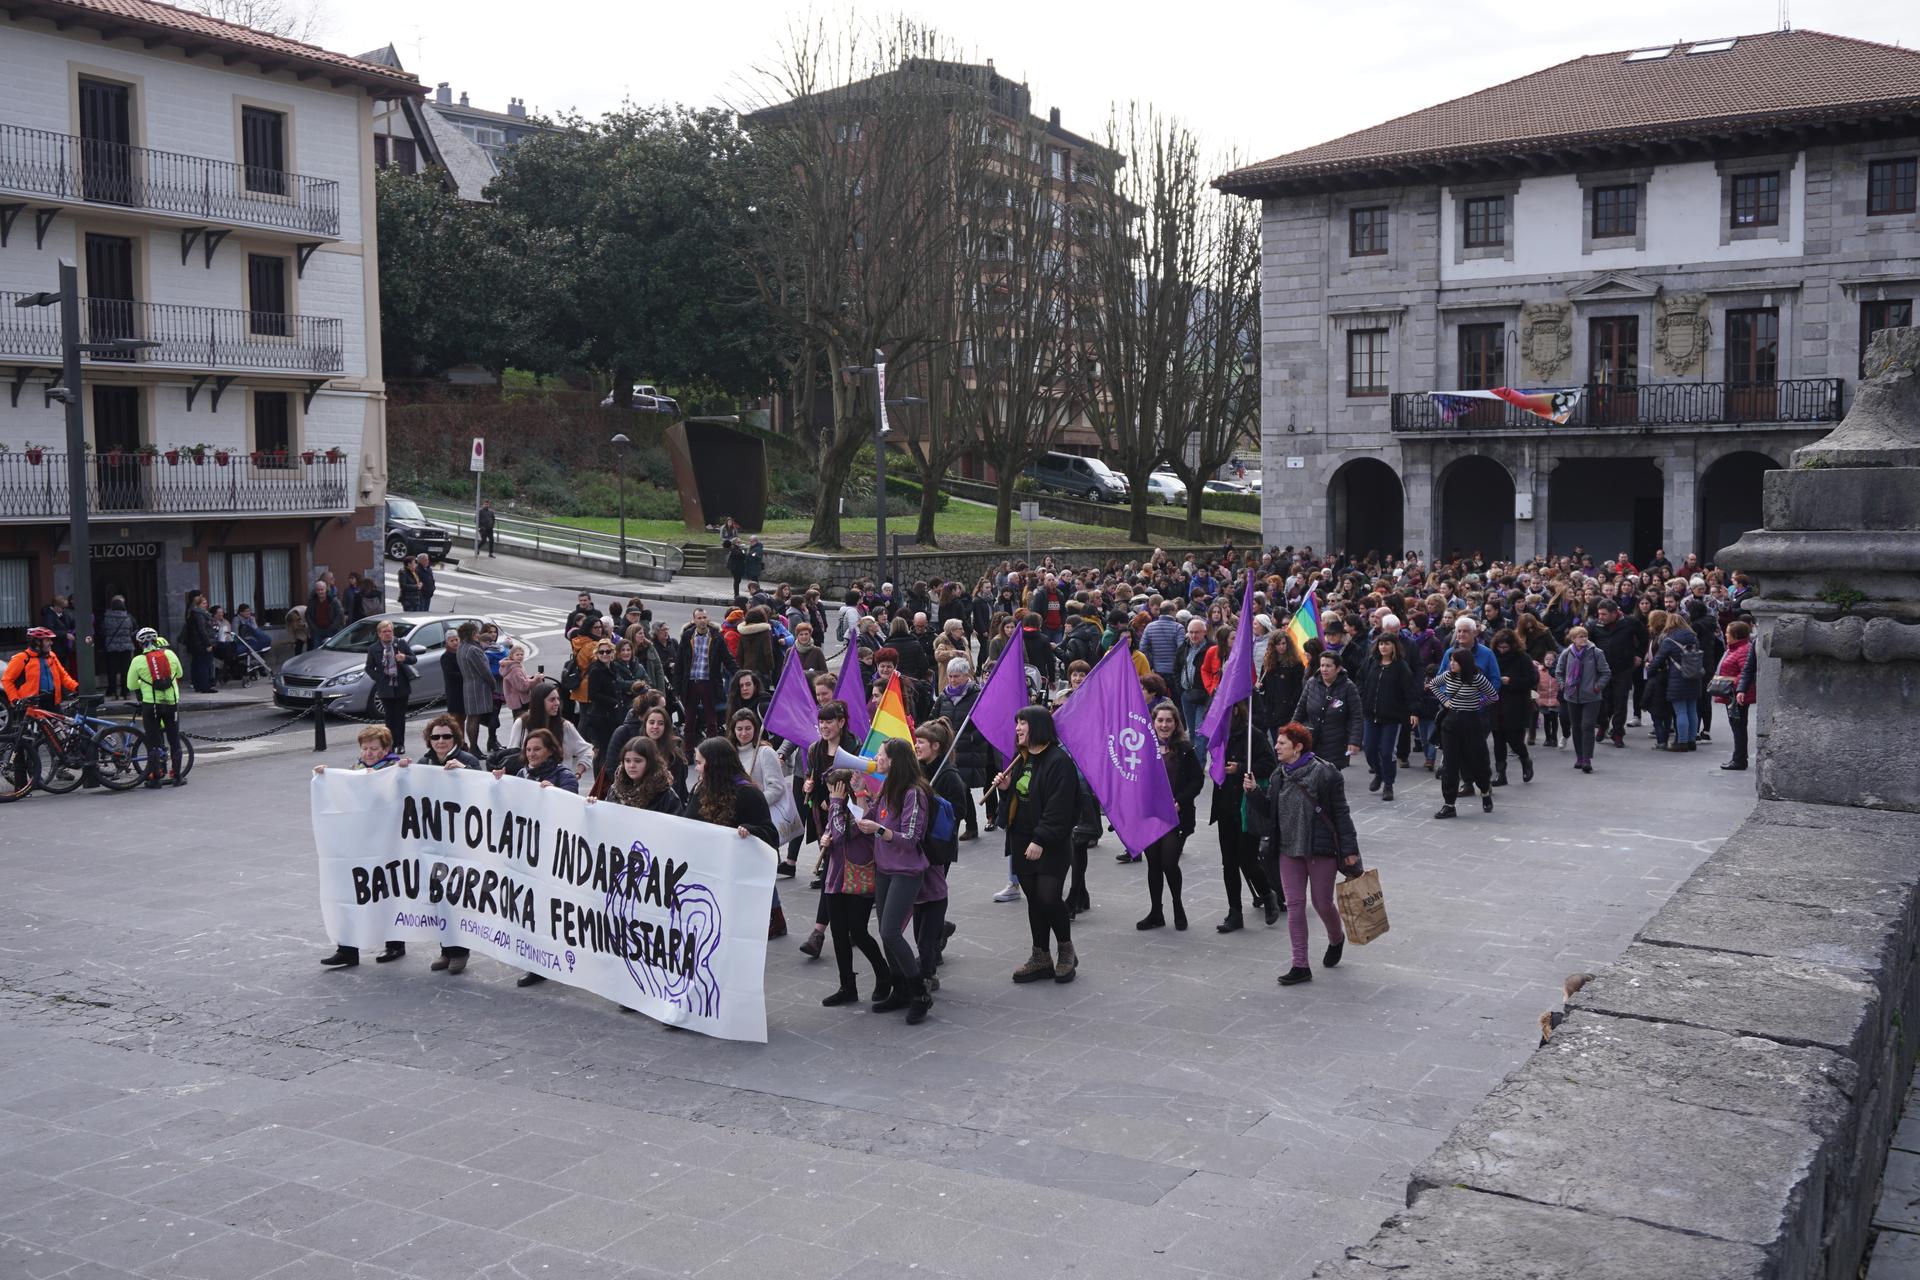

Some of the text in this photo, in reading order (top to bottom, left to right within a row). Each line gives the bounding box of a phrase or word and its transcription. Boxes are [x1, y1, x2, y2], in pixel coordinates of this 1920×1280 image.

[89, 543, 157, 558] ELIZONDO
[400, 796, 689, 913] ANTOLATU INDARRAK
[352, 858, 696, 980] BATU BORROKA FEMINISTARA
[460, 918, 511, 950] ASANBLADA
[516, 938, 562, 972] FEMINISTA
